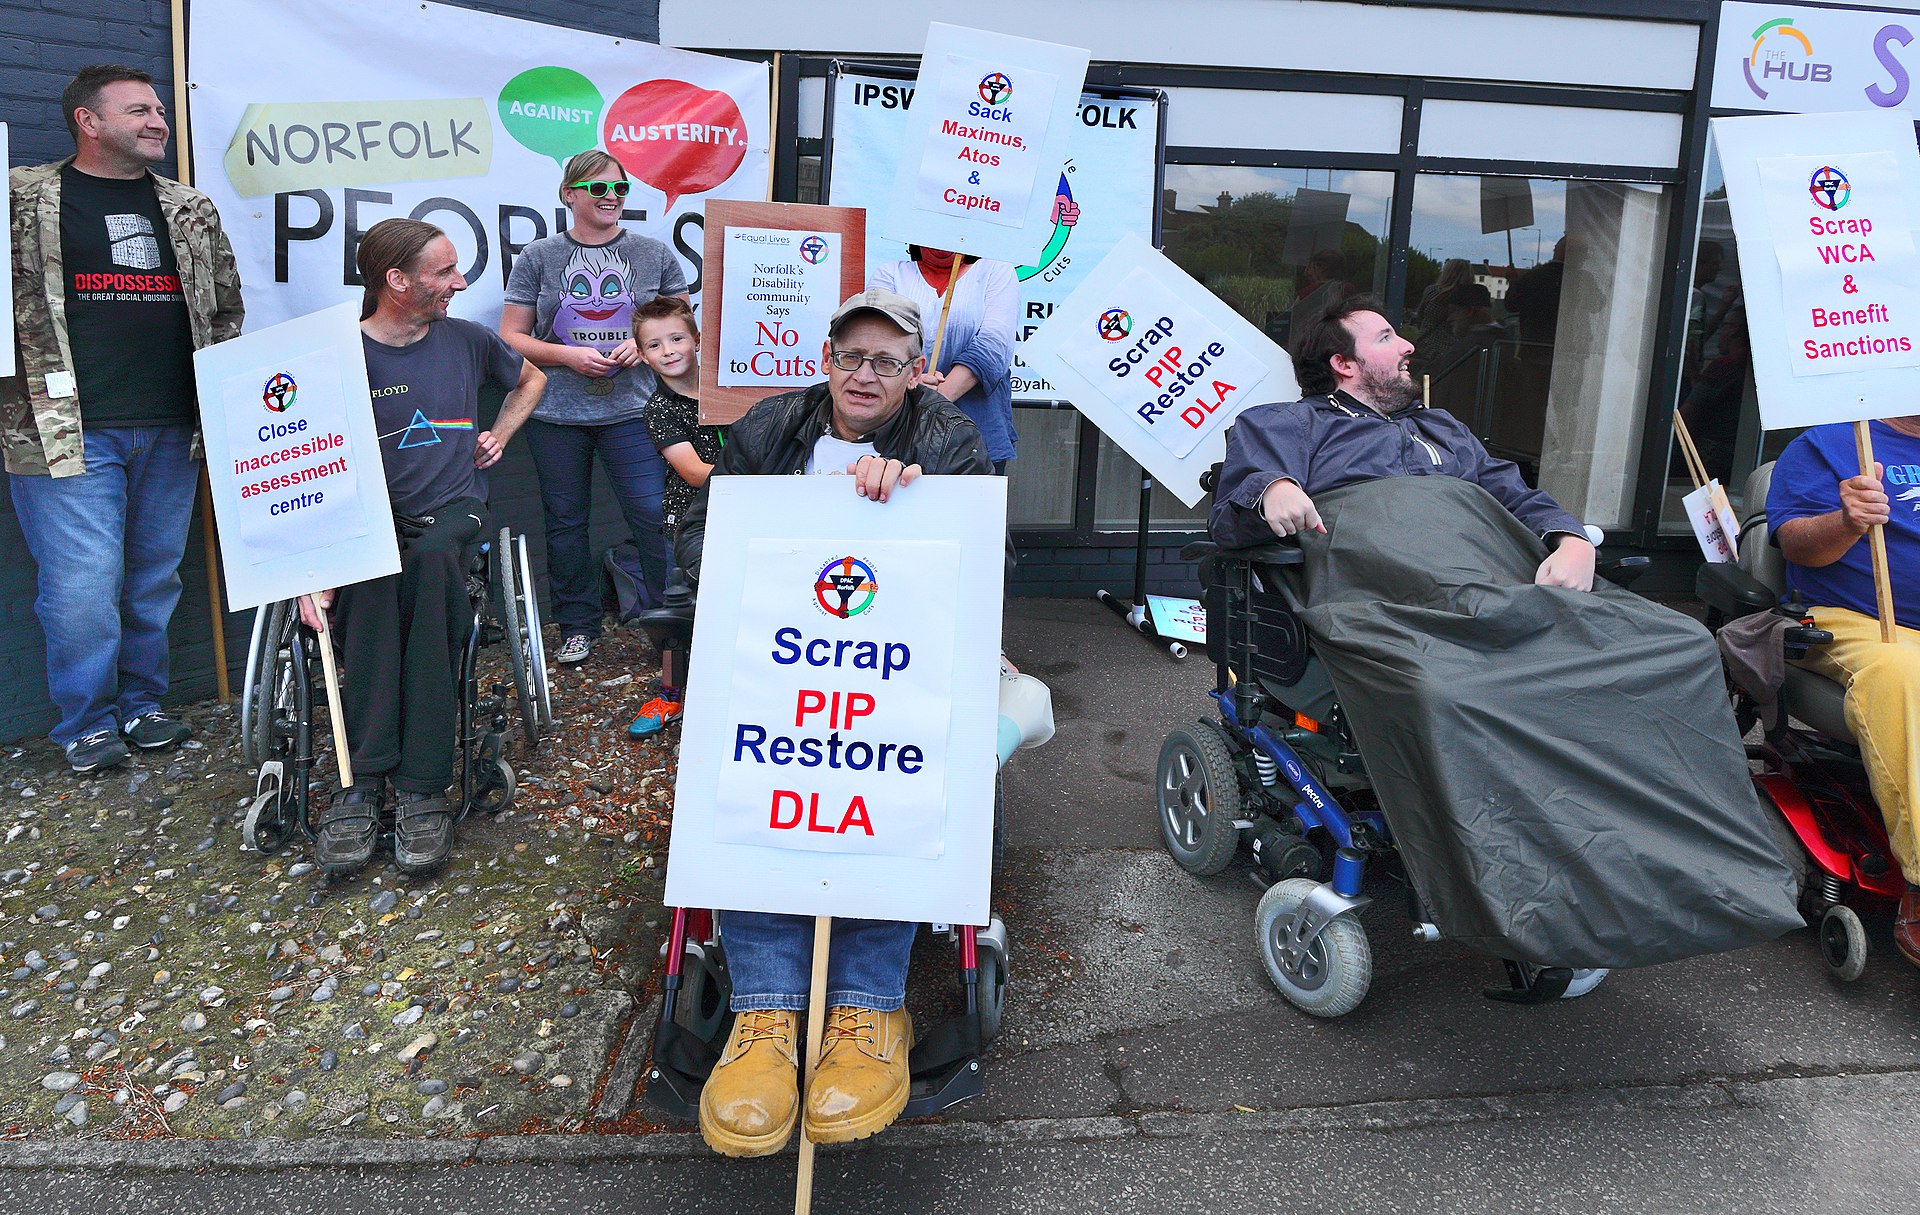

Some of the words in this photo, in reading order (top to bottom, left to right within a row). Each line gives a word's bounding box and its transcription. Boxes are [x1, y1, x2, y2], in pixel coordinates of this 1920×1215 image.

[1765, 49, 1786, 61] THE
[1864, 24, 1915, 108] S
[1763, 60, 1833, 83] HUB
[508, 99, 593, 125] AGAINST
[967, 101, 1013, 123] Sack
[1076, 104, 1138, 130] OLK
[246, 118, 481, 167] NORFOLK
[610, 122, 744, 147] AUSTERITY.
[941, 119, 1027, 152] Maximus,
[957, 146, 1001, 167] Atos
[967, 170, 981, 186] &
[943, 188, 1001, 213] Capita
[741, 233, 767, 245] Equal
[769, 234, 790, 245] Lives
[1809, 216, 1873, 238] Scrap
[1816, 243, 1876, 265] WCA
[754, 263, 804, 276] Norfolk's
[1043, 256, 1071, 283] Cuts
[752, 277, 805, 293] Disability
[1842, 274, 1859, 295] &
[78, 293, 91, 301] THE
[92, 293, 115, 301] GREAT
[116, 293, 142, 302] SOCIAL
[142, 294, 171, 302] HOUSING
[746, 292, 811, 305] community
[766, 304, 790, 318] Says
[1811, 303, 1890, 328] Benefit
[572, 331, 628, 341] TROUBLE
[755, 321, 799, 347] No
[1108, 316, 1174, 378] Scrap
[1803, 334, 1912, 360] Sanctions
[730, 359, 748, 374] to
[750, 350, 816, 377] Cuts
[1144, 346, 1182, 389] PIP
[371, 384, 409, 399] FLOYD
[1010, 377, 1056, 393] @yah
[1137, 342, 1225, 425] Restore
[1180, 380, 1238, 430] DLA
[258, 418, 308, 442] Close
[234, 432, 344, 475] inaccessible
[241, 456, 348, 499] assessment
[270, 491, 324, 516] centre
[771, 627, 911, 680] Scrap
[795, 689, 876, 730] PIP
[733, 723, 924, 775] Restore
[769, 789, 875, 836] DLA
